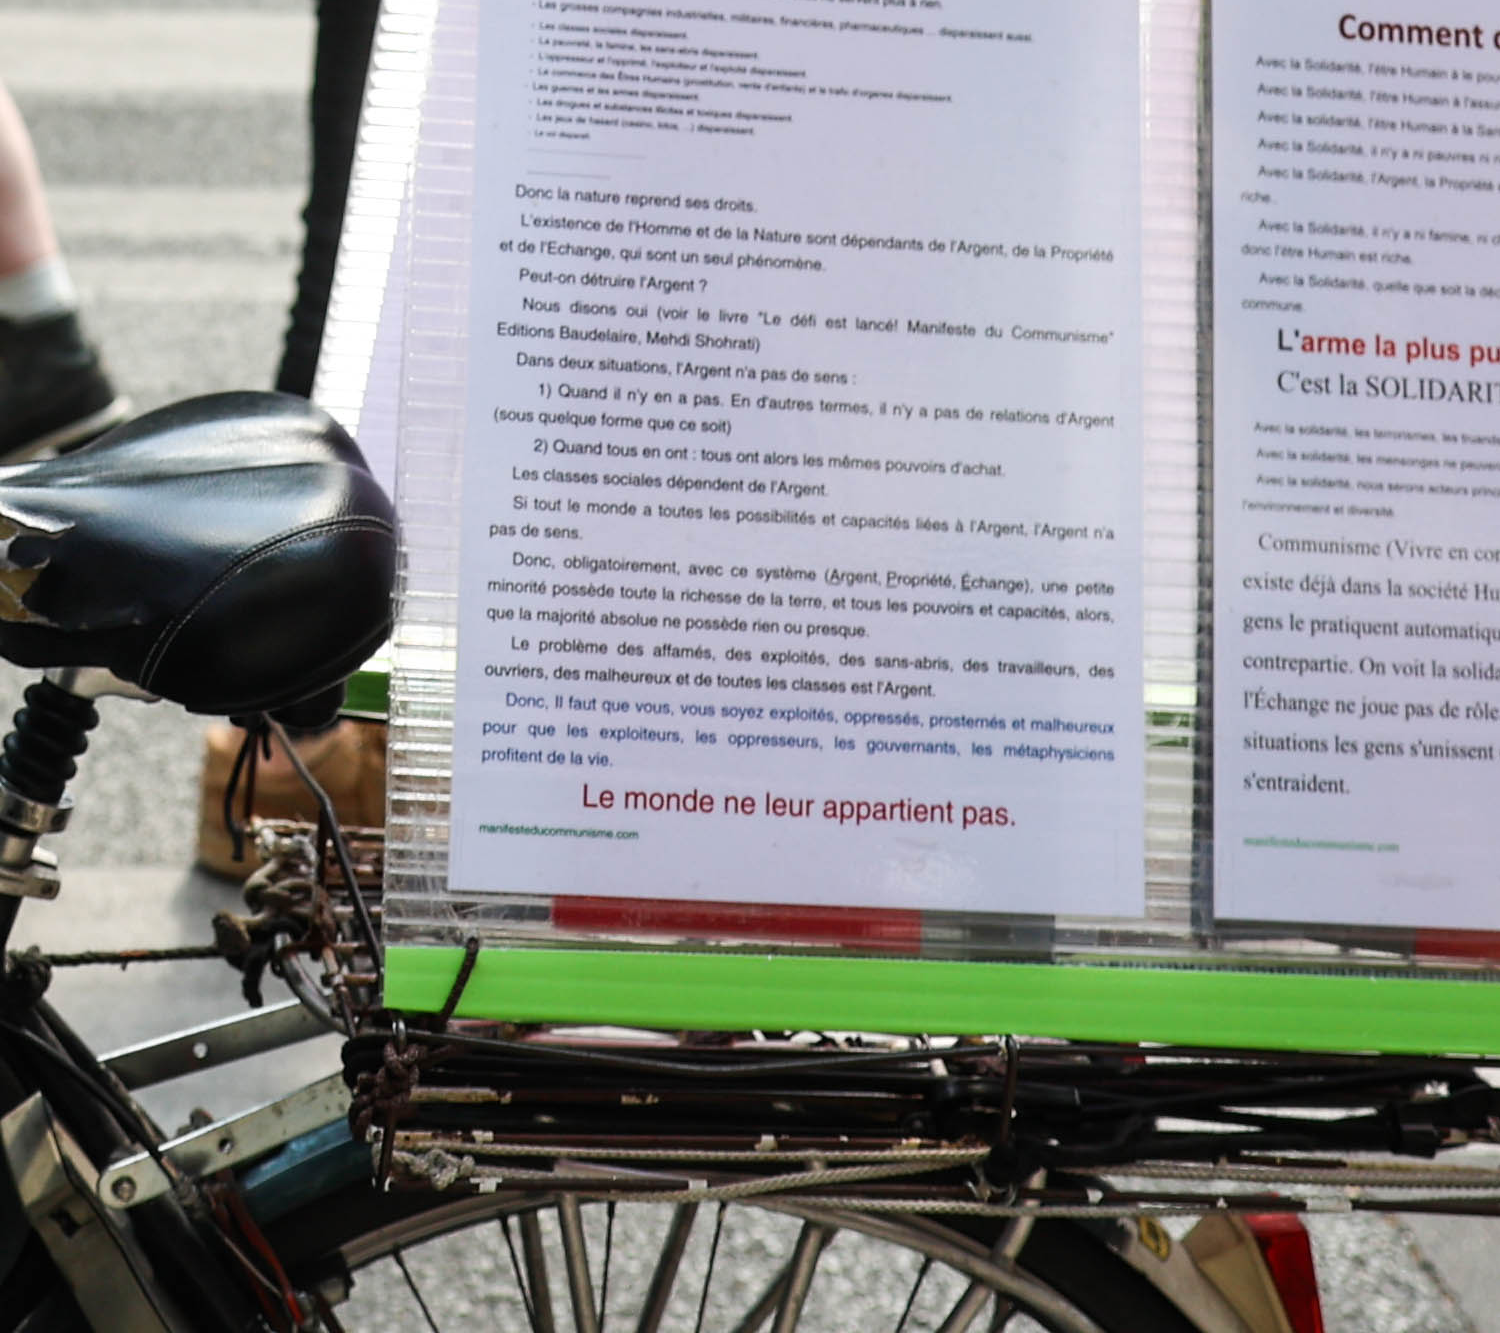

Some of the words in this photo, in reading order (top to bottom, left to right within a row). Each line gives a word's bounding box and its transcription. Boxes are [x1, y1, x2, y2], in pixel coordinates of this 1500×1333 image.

[1338, 13, 1484, 50] Comment
[514, 182, 554, 201] Donc
[557, 186, 571, 202] la
[574, 189, 621, 206] nature
[624, 192, 682, 210] reprend
[684, 196, 711, 211] ses
[713, 197, 759, 214] droits.
[498, 239, 514, 253] et
[517, 238, 537, 255] de
[539, 239, 616, 263] l'Echange,
[619, 246, 643, 263] qui
[645, 249, 678, 263] sont
[680, 252, 700, 264] un
[703, 251, 734, 266] seul
[736, 252, 827, 273] phénomène.
[520, 213, 603, 232] L'existence
[605, 218, 625, 235] de
[627, 218, 693, 239] l'Homme
[695, 225, 711, 240] et
[713, 225, 733, 240] de
[736, 226, 750, 242] la
[753, 226, 803, 245] Nature
[805, 233, 837, 247] sont
[840, 233, 925, 252] dépendants
[927, 239, 947, 253] de
[949, 239, 1008, 258] l'Argent,
[1011, 243, 1030, 258] de
[1033, 244, 1047, 260] la
[1050, 244, 1115, 264] Propriété
[518, 266, 577, 286] Peut-on
[579, 271, 636, 290] détruire
[639, 274, 695, 296] l'Argent
[496, 320, 556, 340] Editions
[559, 324, 642, 346] Baudelaire,
[645, 330, 691, 348] Mehdi
[694, 332, 761, 354] Shohrati)
[522, 296, 561, 314] Nous
[568, 300, 618, 318] disons
[625, 304, 649, 319] oui
[656, 305, 689, 323] (voir
[696, 307, 711, 323] le
[718, 308, 750, 325] livre
[757, 310, 782, 327] "Le
[789, 313, 817, 328] défi
[824, 316, 848, 330] est
[855, 316, 899, 334] lancé!
[906, 319, 977, 338] Manifeste
[984, 325, 1004, 339] du
[1010, 324, 1114, 345] Communisme"
[1277, 327, 1367, 357] L'arme
[1375, 334, 1397, 358] la
[1405, 336, 1461, 366] plus
[1276, 370, 1331, 396] C'est
[1339, 372, 1359, 397] la
[1257, 531, 1382, 558] Communisme
[1385, 538, 1444, 561] (Vivre
[1447, 546, 1469, 562] en
[1242, 571, 1295, 593] existe
[1298, 572, 1337, 600] déjà
[1340, 575, 1382, 597] dans
[1386, 578, 1404, 598] la
[1407, 581, 1469, 601] société
[1242, 615, 1284, 634] gens
[1289, 612, 1306, 633] le
[1309, 615, 1399, 640] pratiquent
[582, 782, 615, 810] Le
[624, 788, 715, 814] monde
[724, 794, 757, 816] ne
[765, 791, 815, 818] leur
[822, 797, 954, 826] appartient
[962, 804, 1016, 831] pas.
